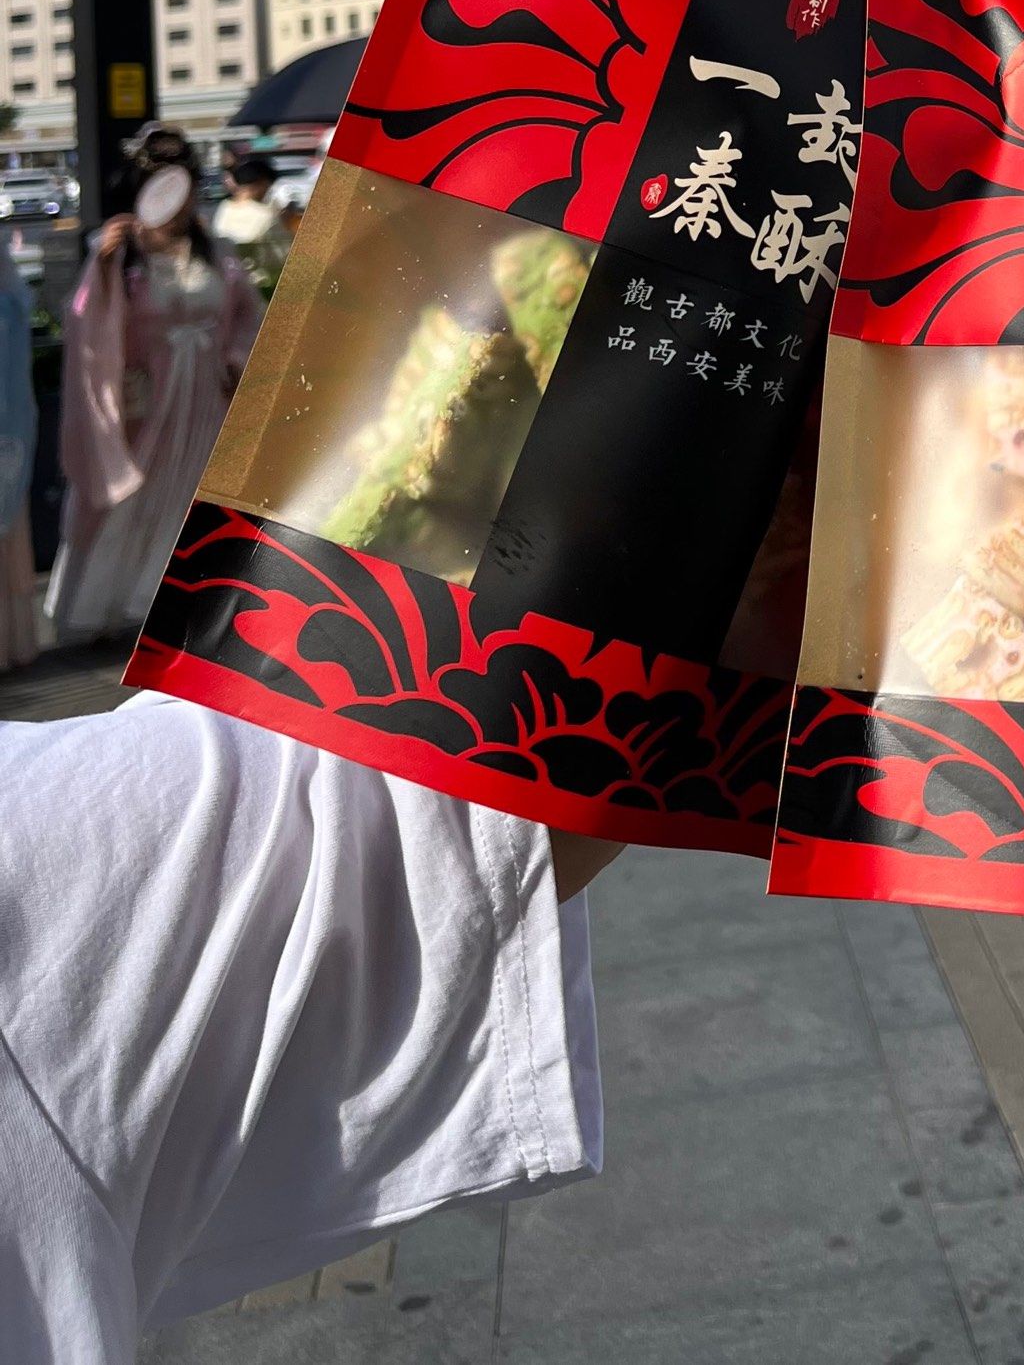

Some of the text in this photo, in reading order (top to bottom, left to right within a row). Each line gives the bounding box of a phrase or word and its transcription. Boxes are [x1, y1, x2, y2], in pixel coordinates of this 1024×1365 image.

[621, 277, 803, 361] 觀古都文化
[608, 325, 785, 406] 品西安美味
